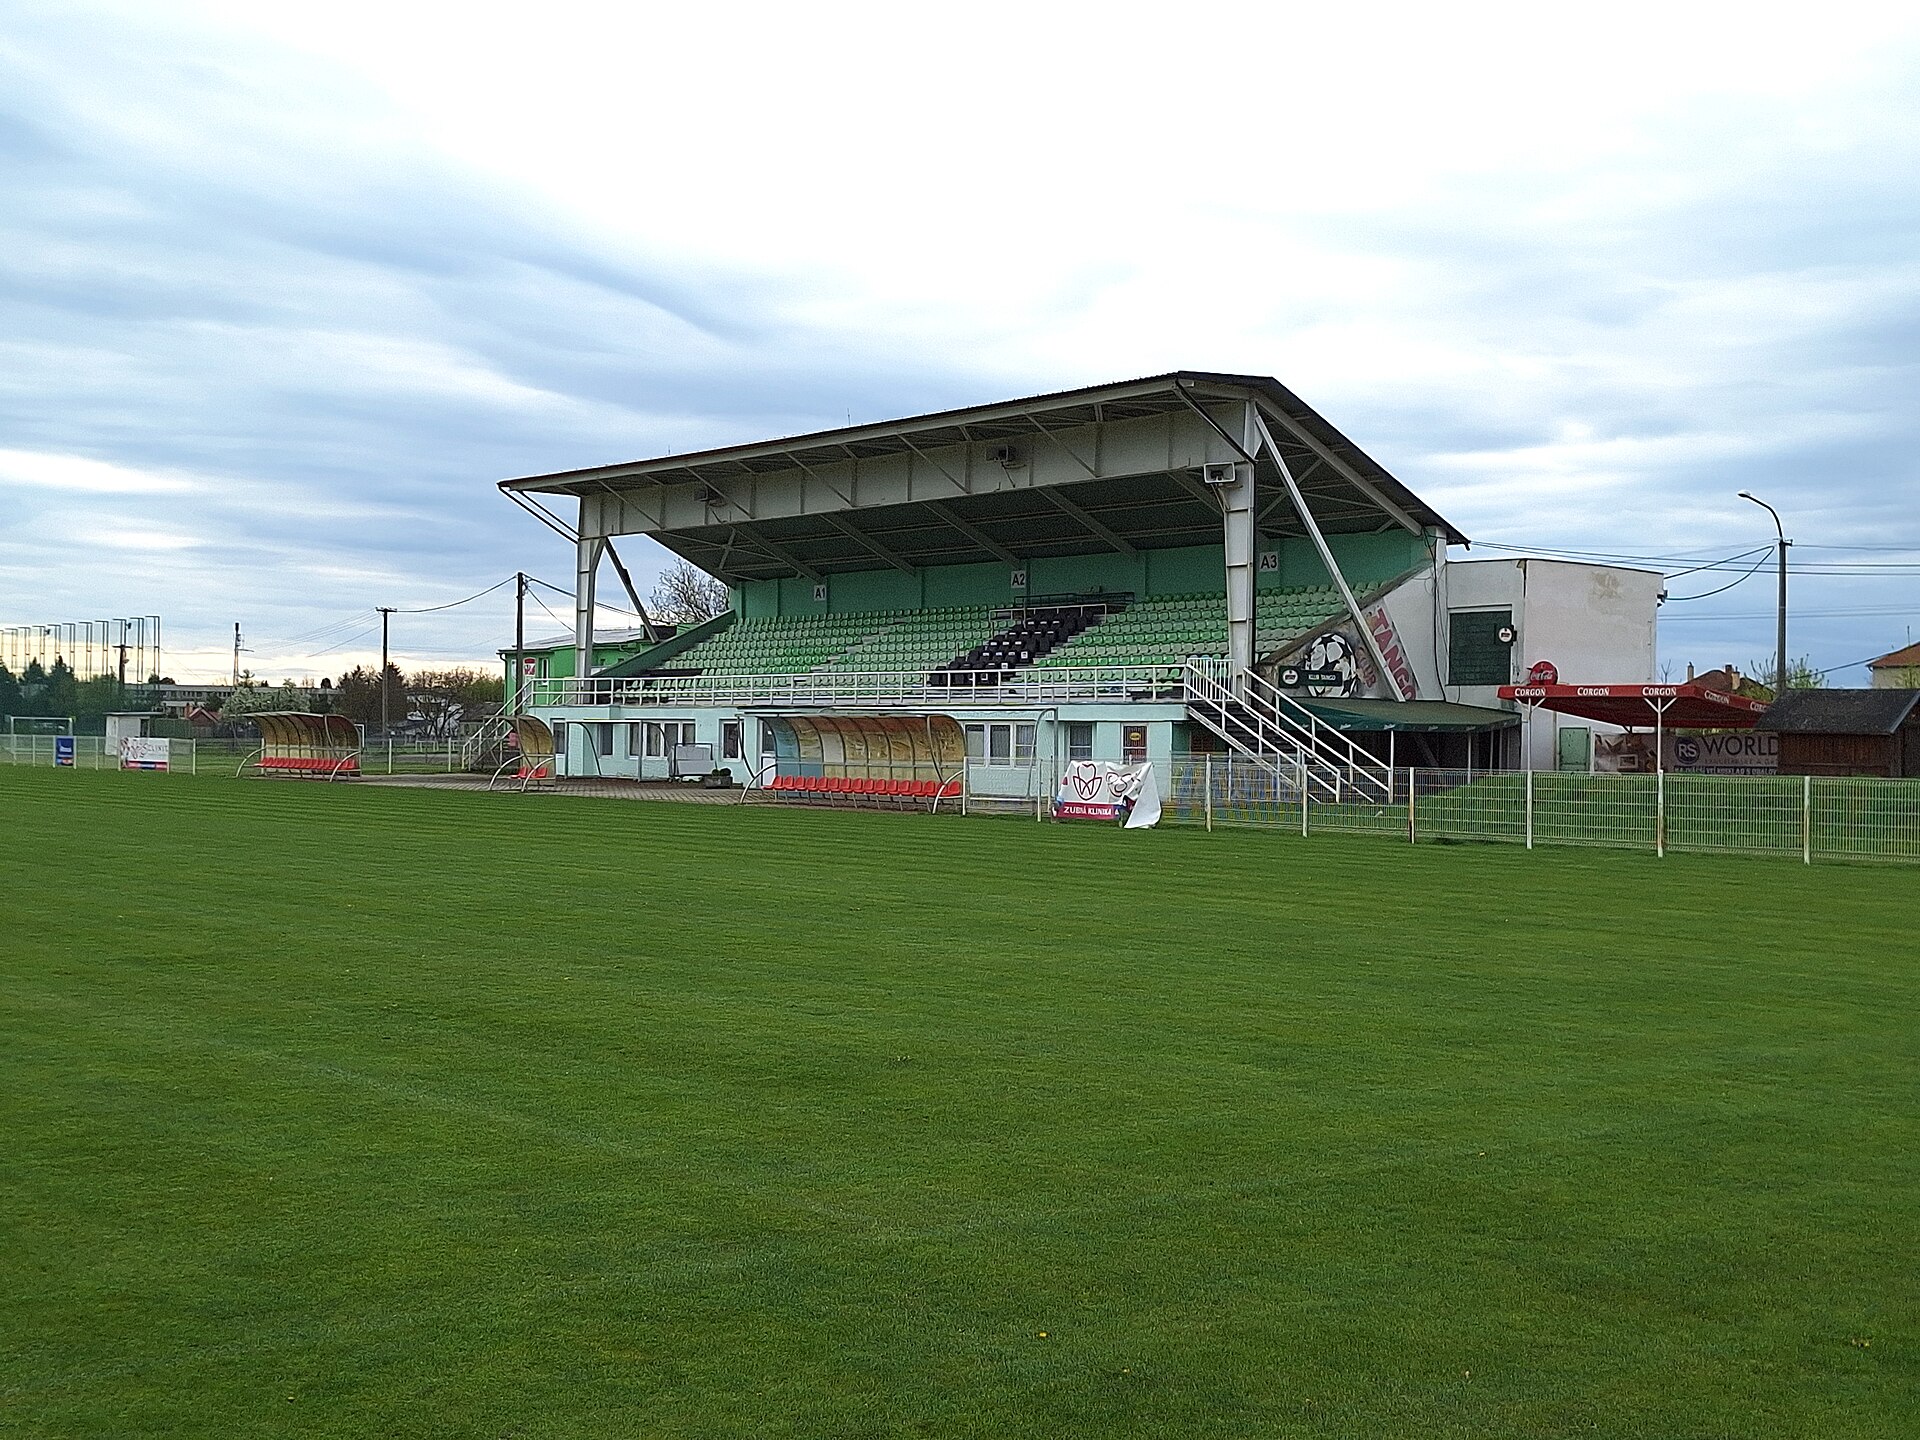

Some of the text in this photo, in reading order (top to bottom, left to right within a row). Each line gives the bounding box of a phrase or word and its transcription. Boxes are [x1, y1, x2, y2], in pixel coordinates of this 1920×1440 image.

[1261, 555, 1277, 569] A3
[1012, 573, 1024, 586] A2
[815, 587, 825, 598] A1
[1373, 607, 1416, 700] TANGO
[1678, 735, 1778, 757] RS WORLD
